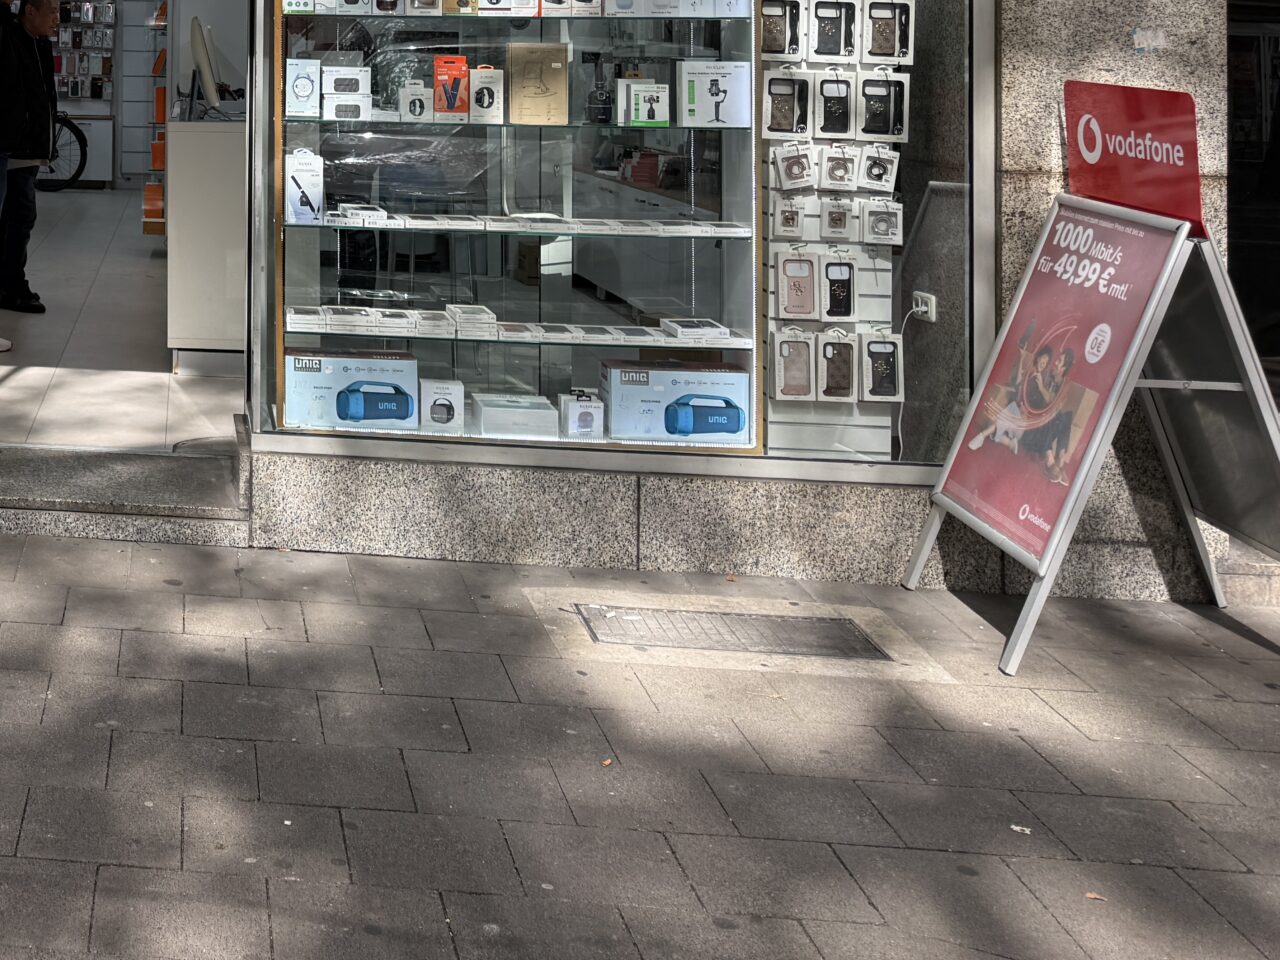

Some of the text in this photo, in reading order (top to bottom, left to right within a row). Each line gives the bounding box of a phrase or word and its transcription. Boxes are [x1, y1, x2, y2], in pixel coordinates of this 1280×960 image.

[1105, 130, 1185, 167] vodafone
[1052, 221, 1123, 265] 1000 Mbit/s
[1037, 255, 1054, 274] für
[1053, 253, 1101, 288] 49,99
[1098, 266, 1116, 294] €
[295, 358, 321, 369] UNIQ
[621, 371, 648, 382] UNIQ
[378, 401, 397, 410] UNIQ
[708, 415, 728, 425] UNIQ
